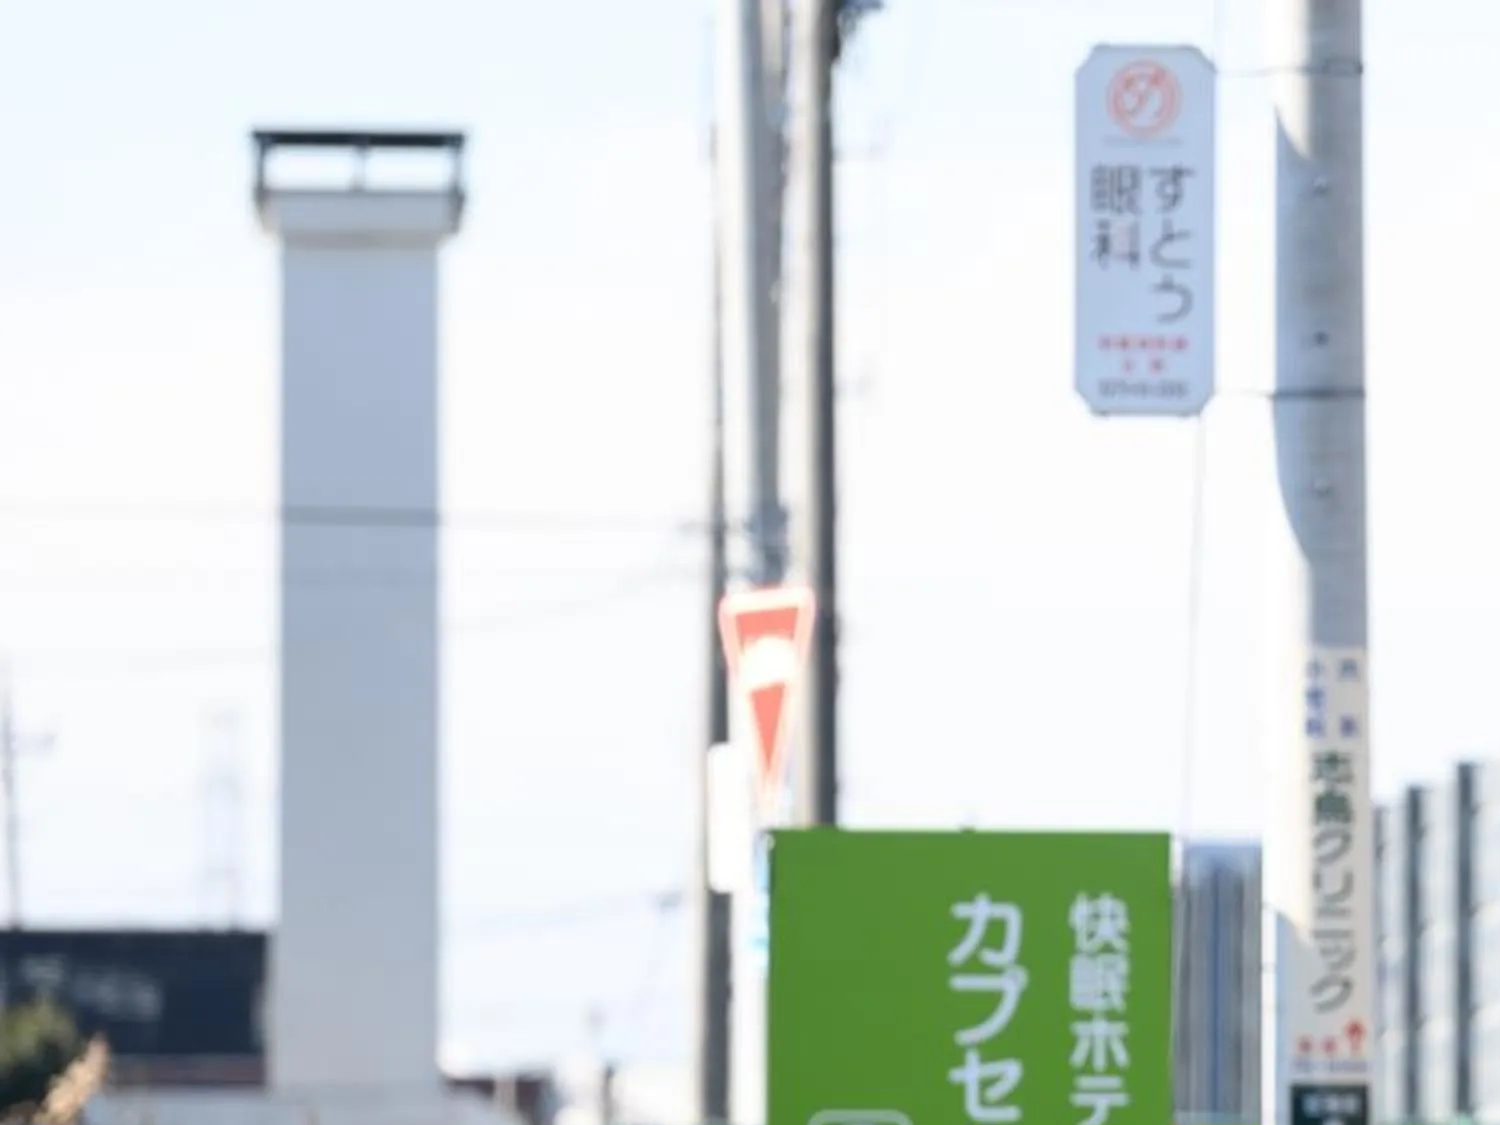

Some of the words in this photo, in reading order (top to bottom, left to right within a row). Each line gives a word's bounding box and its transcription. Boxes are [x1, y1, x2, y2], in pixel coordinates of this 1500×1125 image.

[1090, 164, 1142, 268] 眼科
[1150, 165, 1196, 323] すとう
